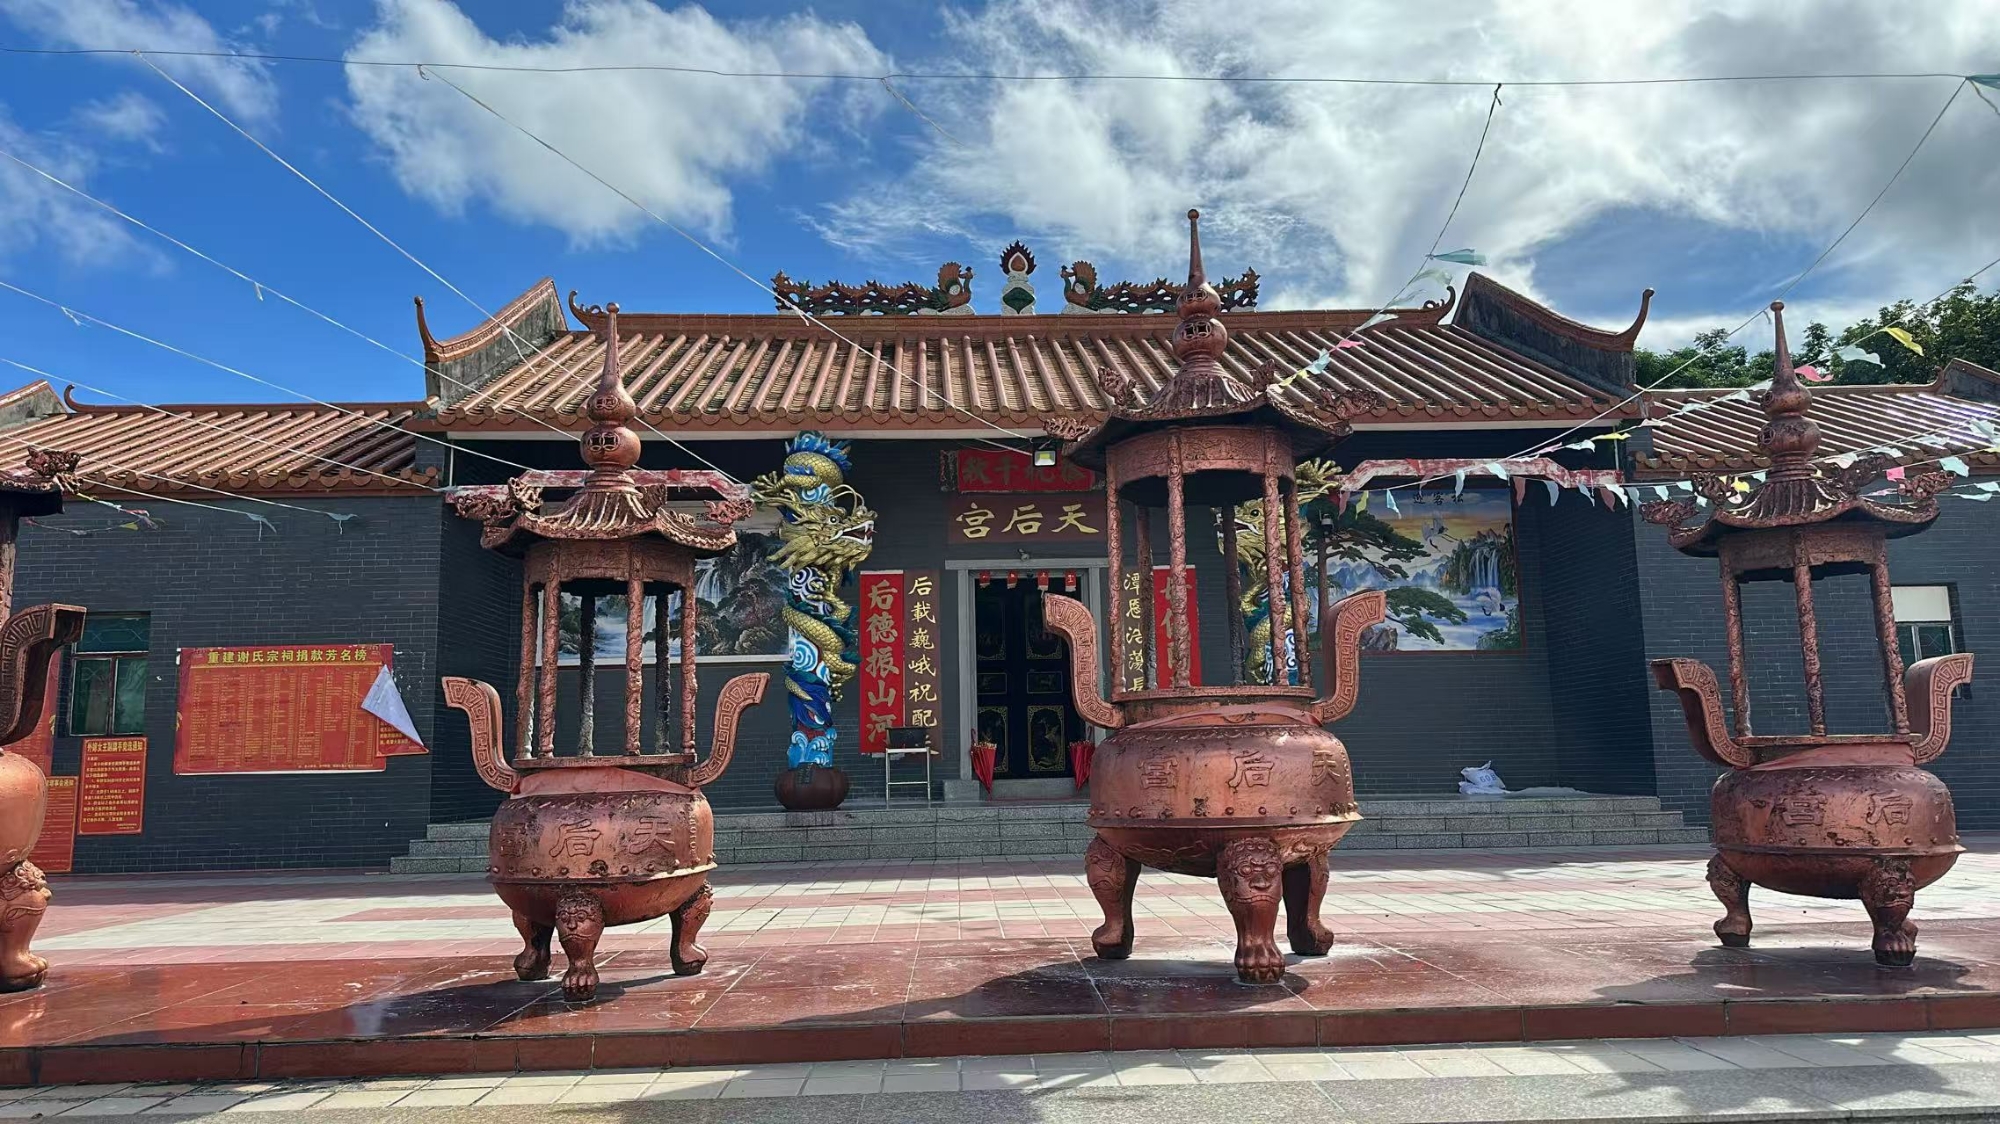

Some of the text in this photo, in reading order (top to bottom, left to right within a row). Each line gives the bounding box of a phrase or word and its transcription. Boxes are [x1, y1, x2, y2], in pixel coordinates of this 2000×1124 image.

[208, 648, 367, 664] 重建谢氏宗祠捐款芳名榜
